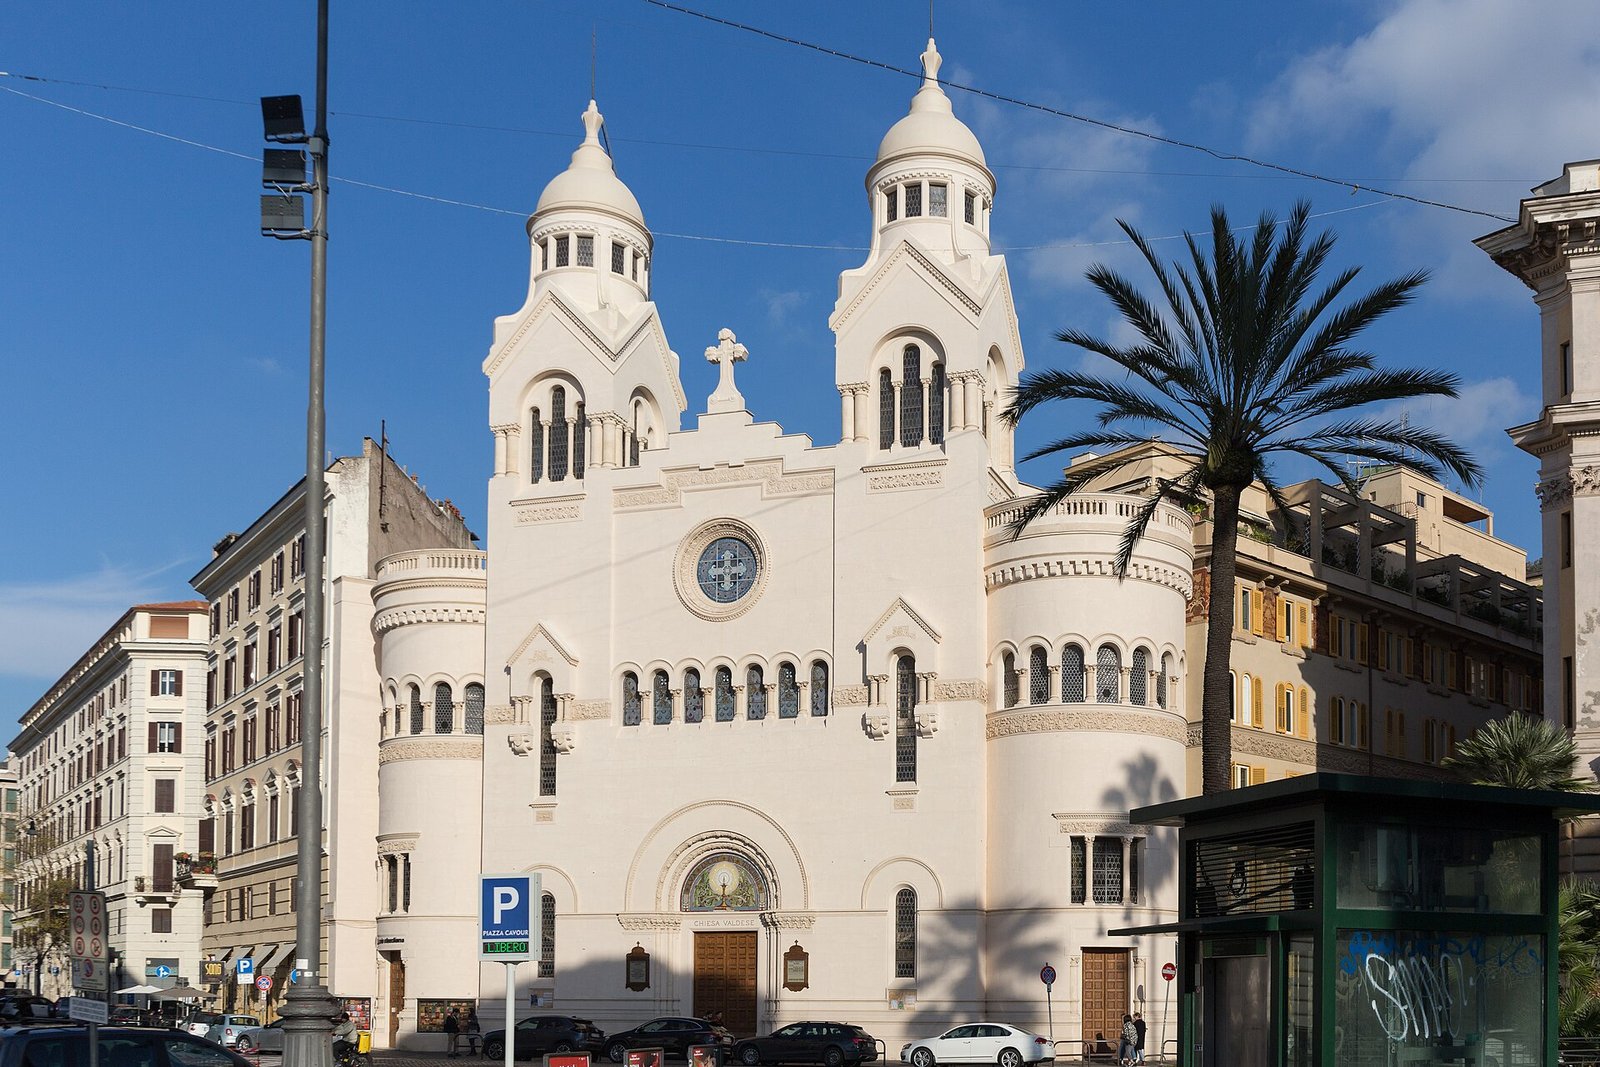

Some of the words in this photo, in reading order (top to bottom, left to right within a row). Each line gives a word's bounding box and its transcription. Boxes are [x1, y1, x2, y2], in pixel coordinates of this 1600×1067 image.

[493, 886, 520, 924] P
[487, 942, 526, 953] LIBERO
[239, 960, 251, 973] P
